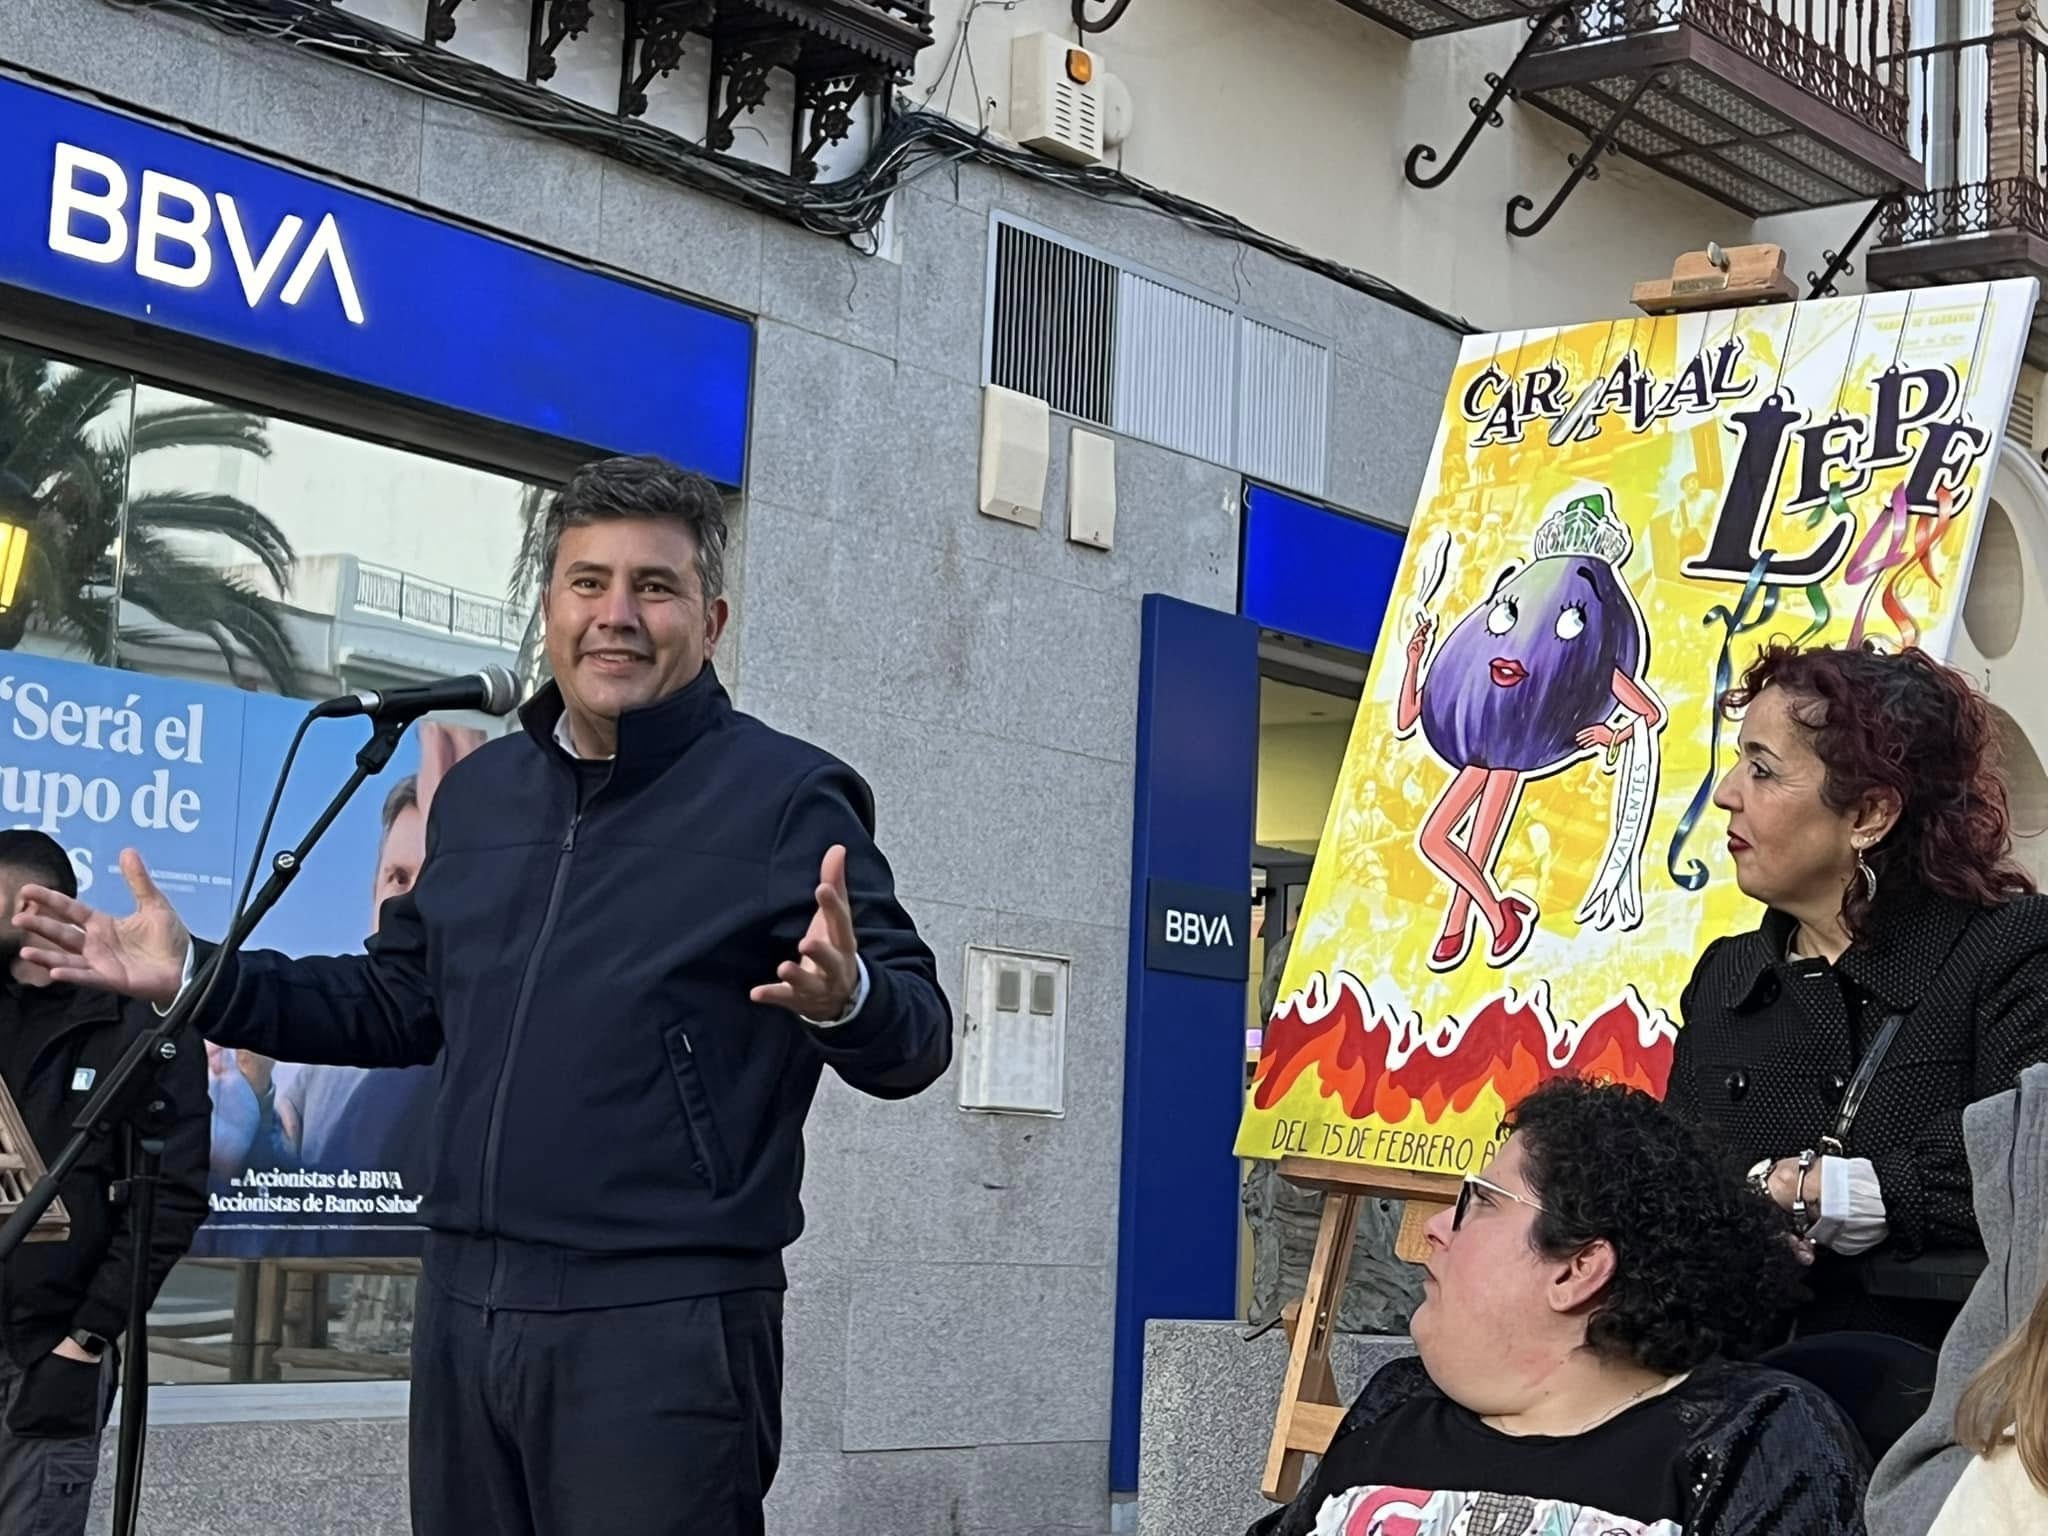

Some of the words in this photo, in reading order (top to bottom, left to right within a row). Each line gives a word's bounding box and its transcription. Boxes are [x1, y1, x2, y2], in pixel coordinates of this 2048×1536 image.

[48, 142, 364, 324] BBVA
[1684, 364, 1989, 585] LEPE
[155, 703, 204, 764] el
[0, 764, 121, 834] upo
[131, 769, 201, 833] de
[1610, 763, 1646, 870] VALIENTES
[1166, 909, 1233, 947] BBVA
[1271, 1119, 1308, 1153] DEL
[1345, 1126, 1371, 1159] DE
[1373, 1129, 1473, 1170] FEBRERO
[208, 1192, 300, 1213] Accionistas
[302, 1193, 324, 1212] de
[325, 1194, 374, 1213] Banco
[243, 1167, 336, 1188] Accionistas
[337, 1169, 358, 1188] de
[359, 1171, 403, 1190] BBVA
